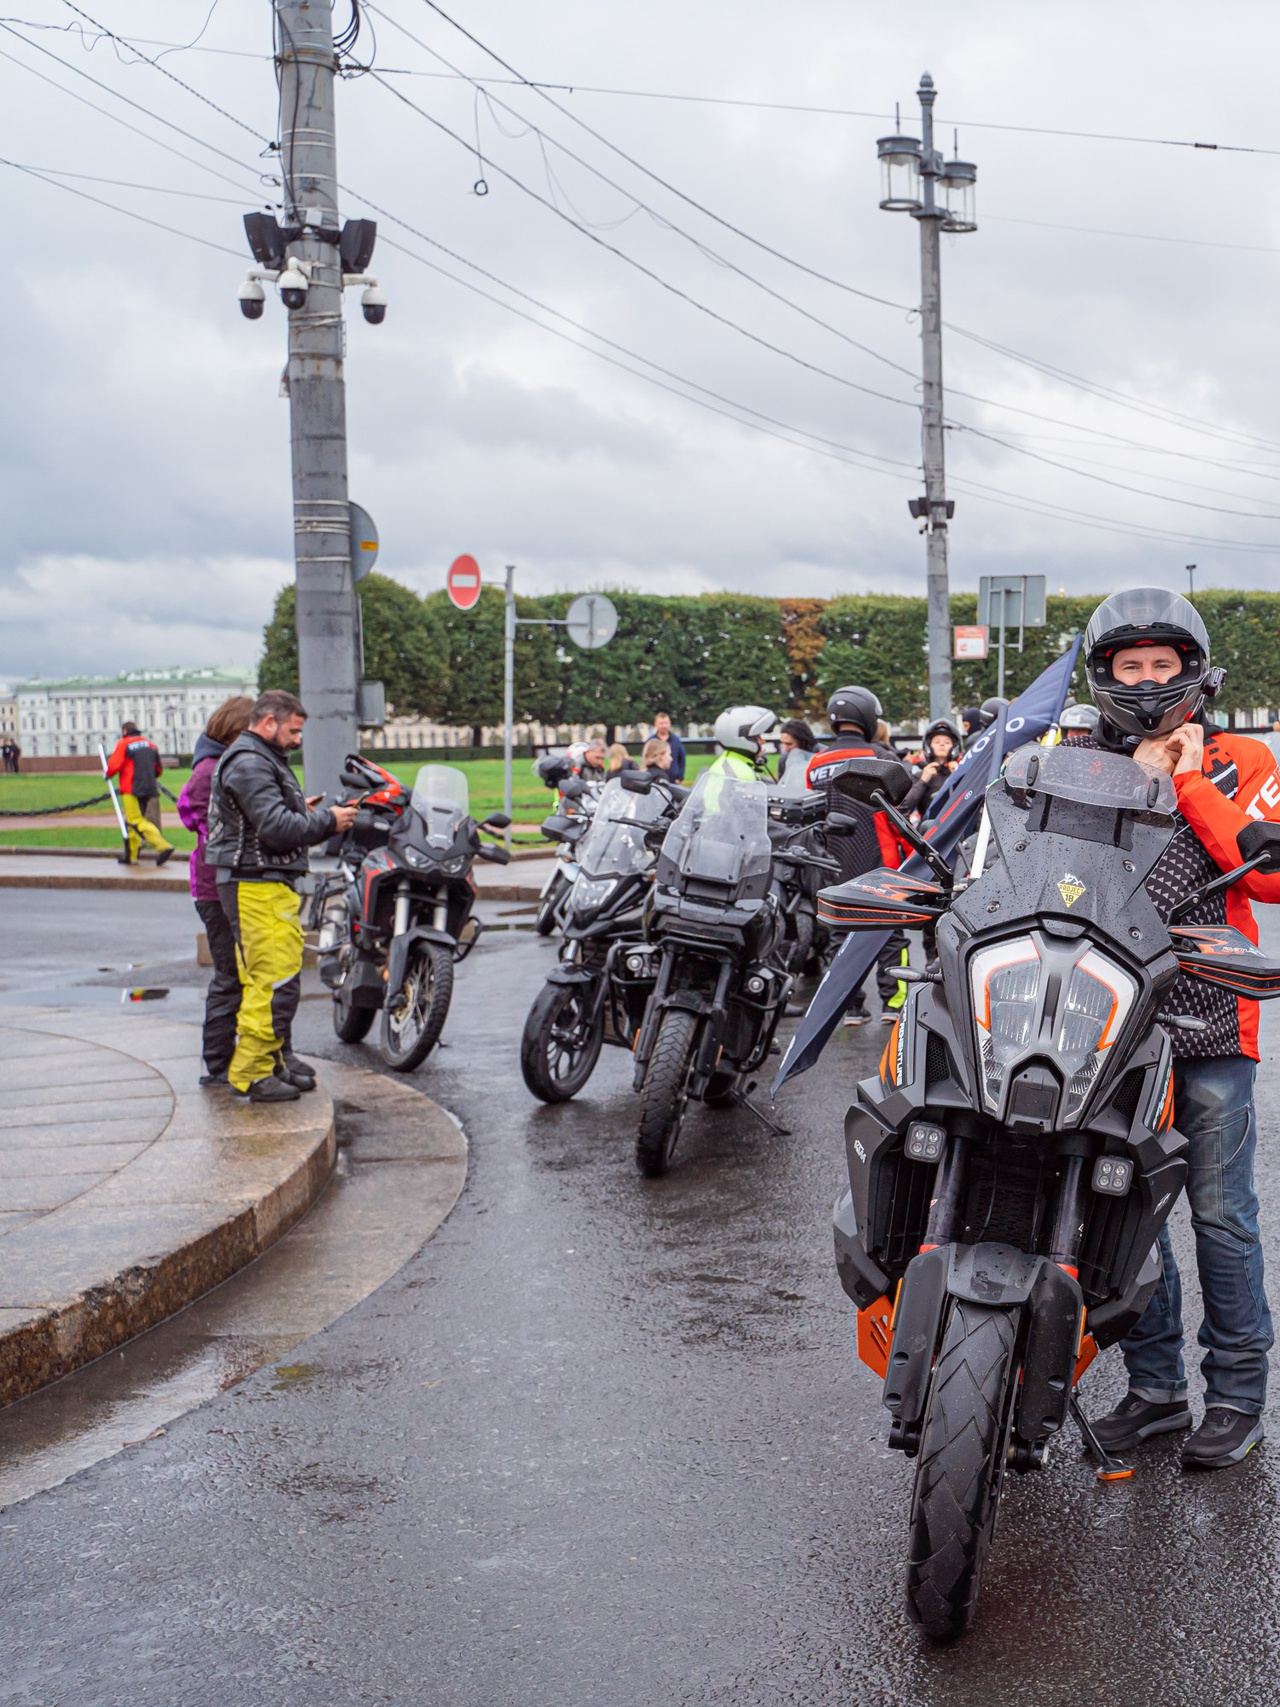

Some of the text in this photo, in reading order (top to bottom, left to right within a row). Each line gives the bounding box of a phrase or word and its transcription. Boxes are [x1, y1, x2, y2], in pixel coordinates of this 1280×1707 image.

[1060, 884, 1084, 895] PROJECT
[1065, 894, 1074, 902] 18
[896, 1022, 905, 1087] ADVENTURE
